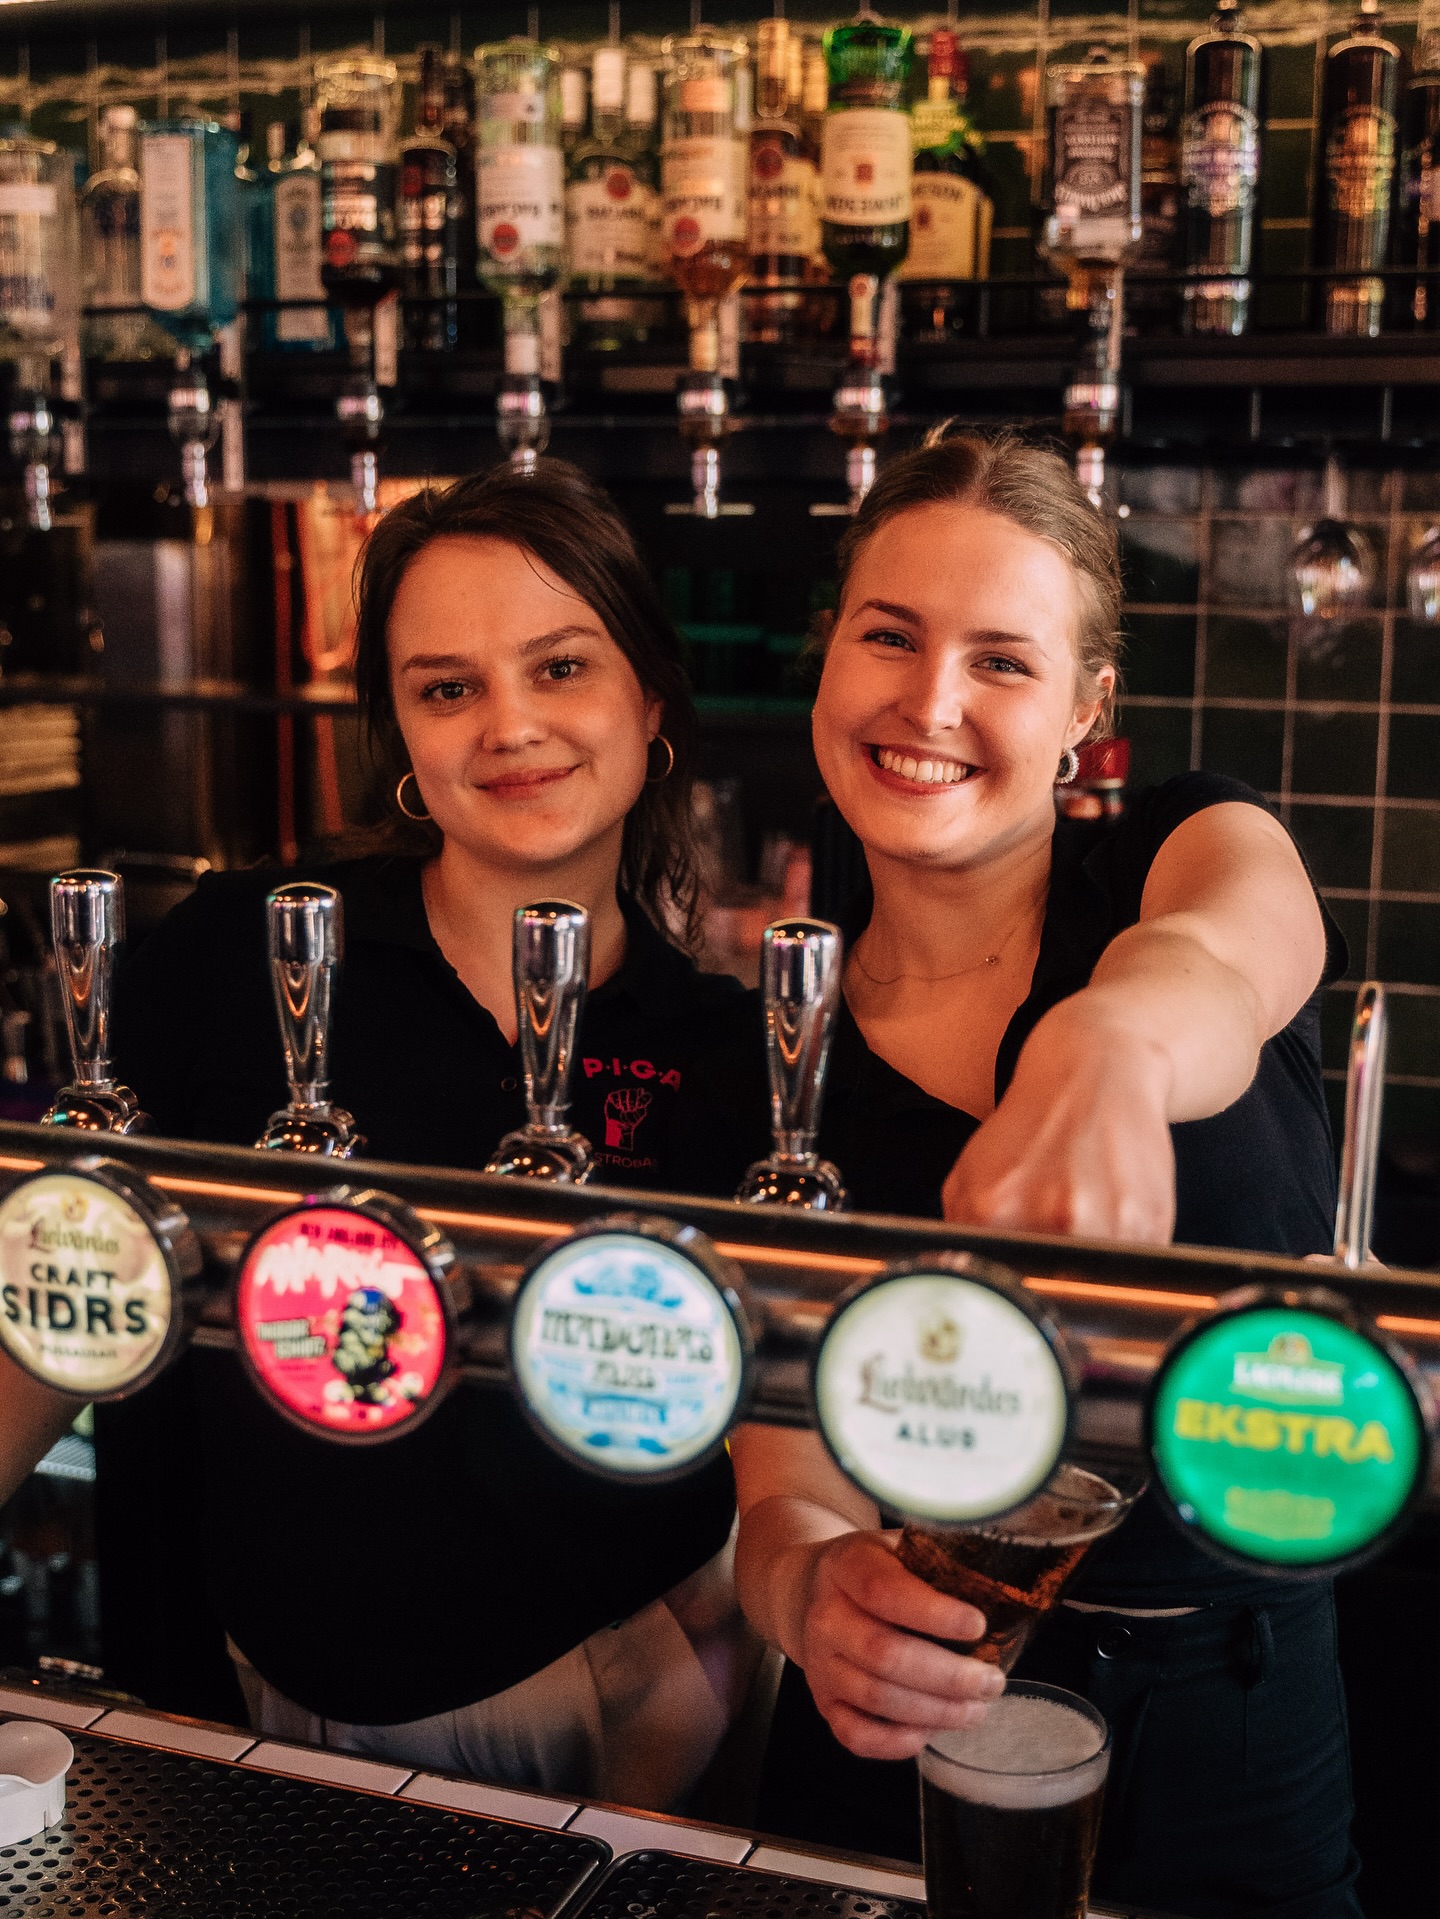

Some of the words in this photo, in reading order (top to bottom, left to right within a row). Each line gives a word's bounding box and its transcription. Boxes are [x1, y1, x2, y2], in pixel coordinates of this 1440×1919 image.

[31, 1263, 114, 1289] CRAFT
[2, 1284, 147, 1336] SIDRS
[896, 1423, 975, 1449] ALUS
[1173, 1397, 1395, 1464] EKSTRA
